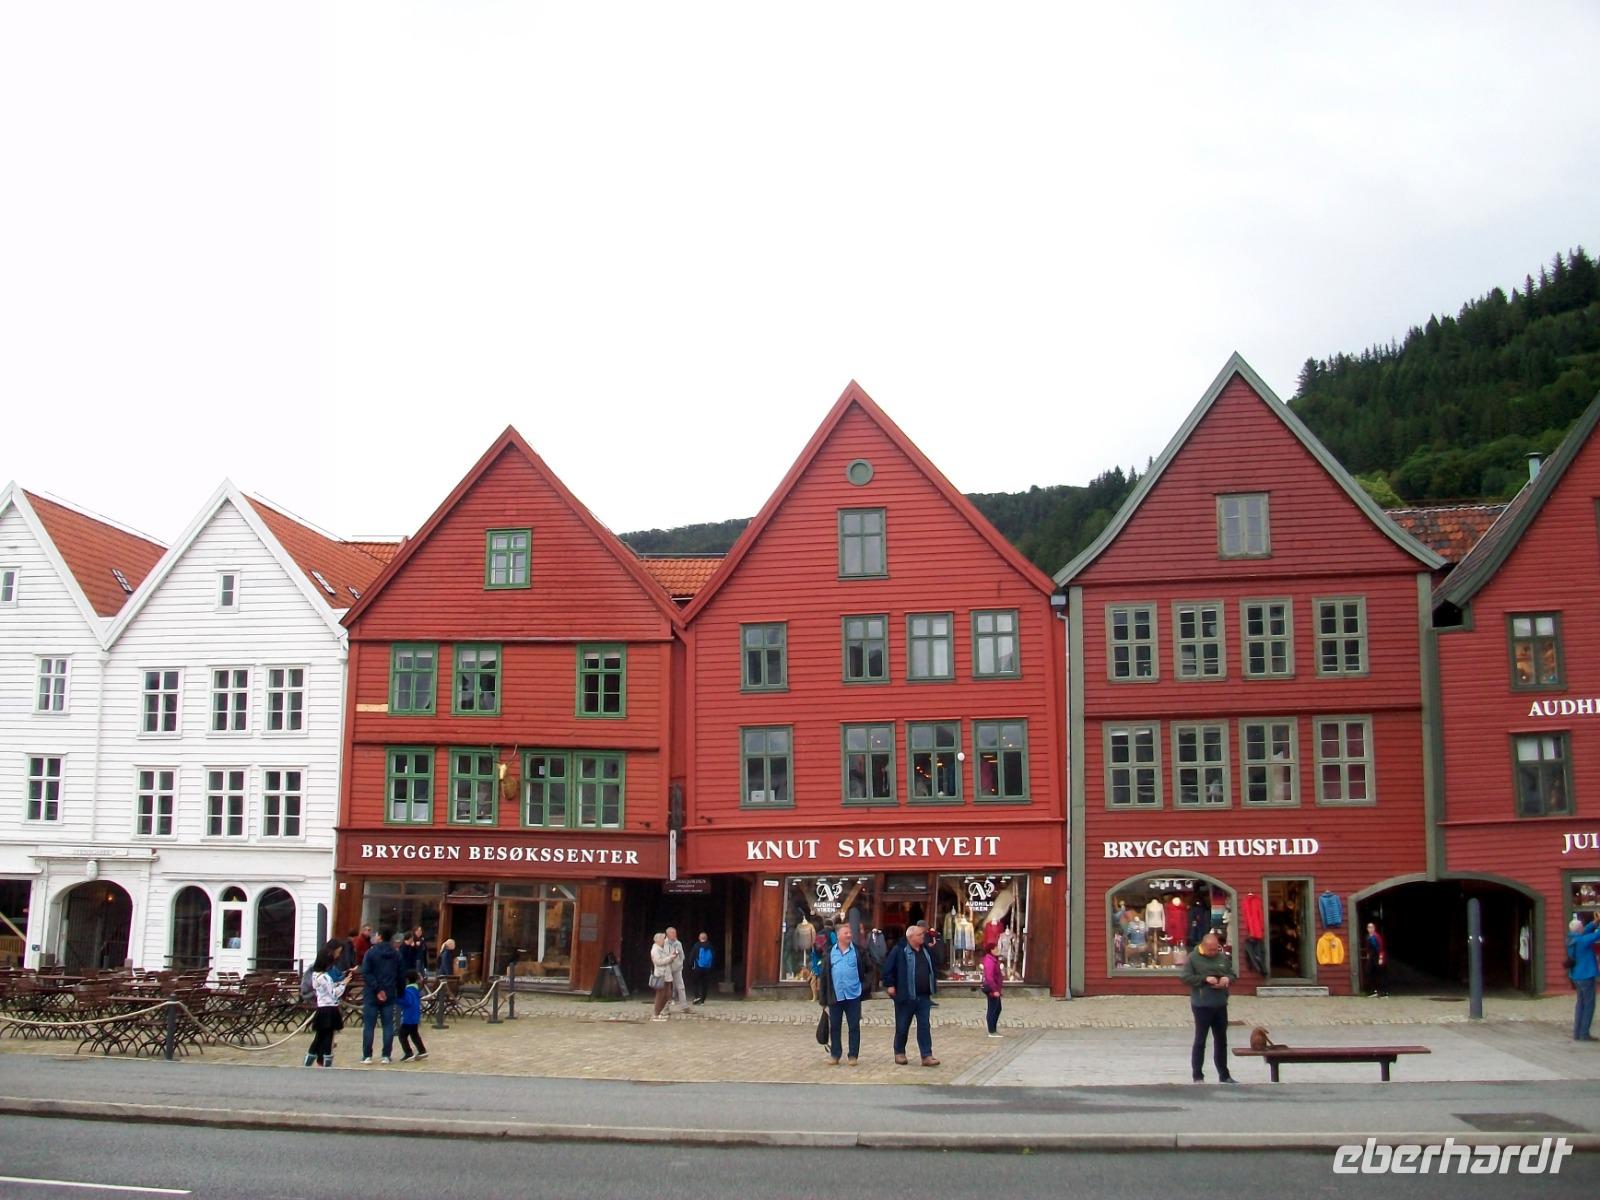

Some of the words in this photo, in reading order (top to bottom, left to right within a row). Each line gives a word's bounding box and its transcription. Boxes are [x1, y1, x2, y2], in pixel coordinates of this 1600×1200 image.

[361, 844, 461, 861] BRYGGEN
[468, 846, 639, 865] BESØKSSENTER
[747, 839, 820, 860] KNUT
[838, 836, 1001, 858] SKURTVEIT
[1103, 839, 1209, 858] BRYGGEN
[1217, 838, 1319, 857] HUSFLID
